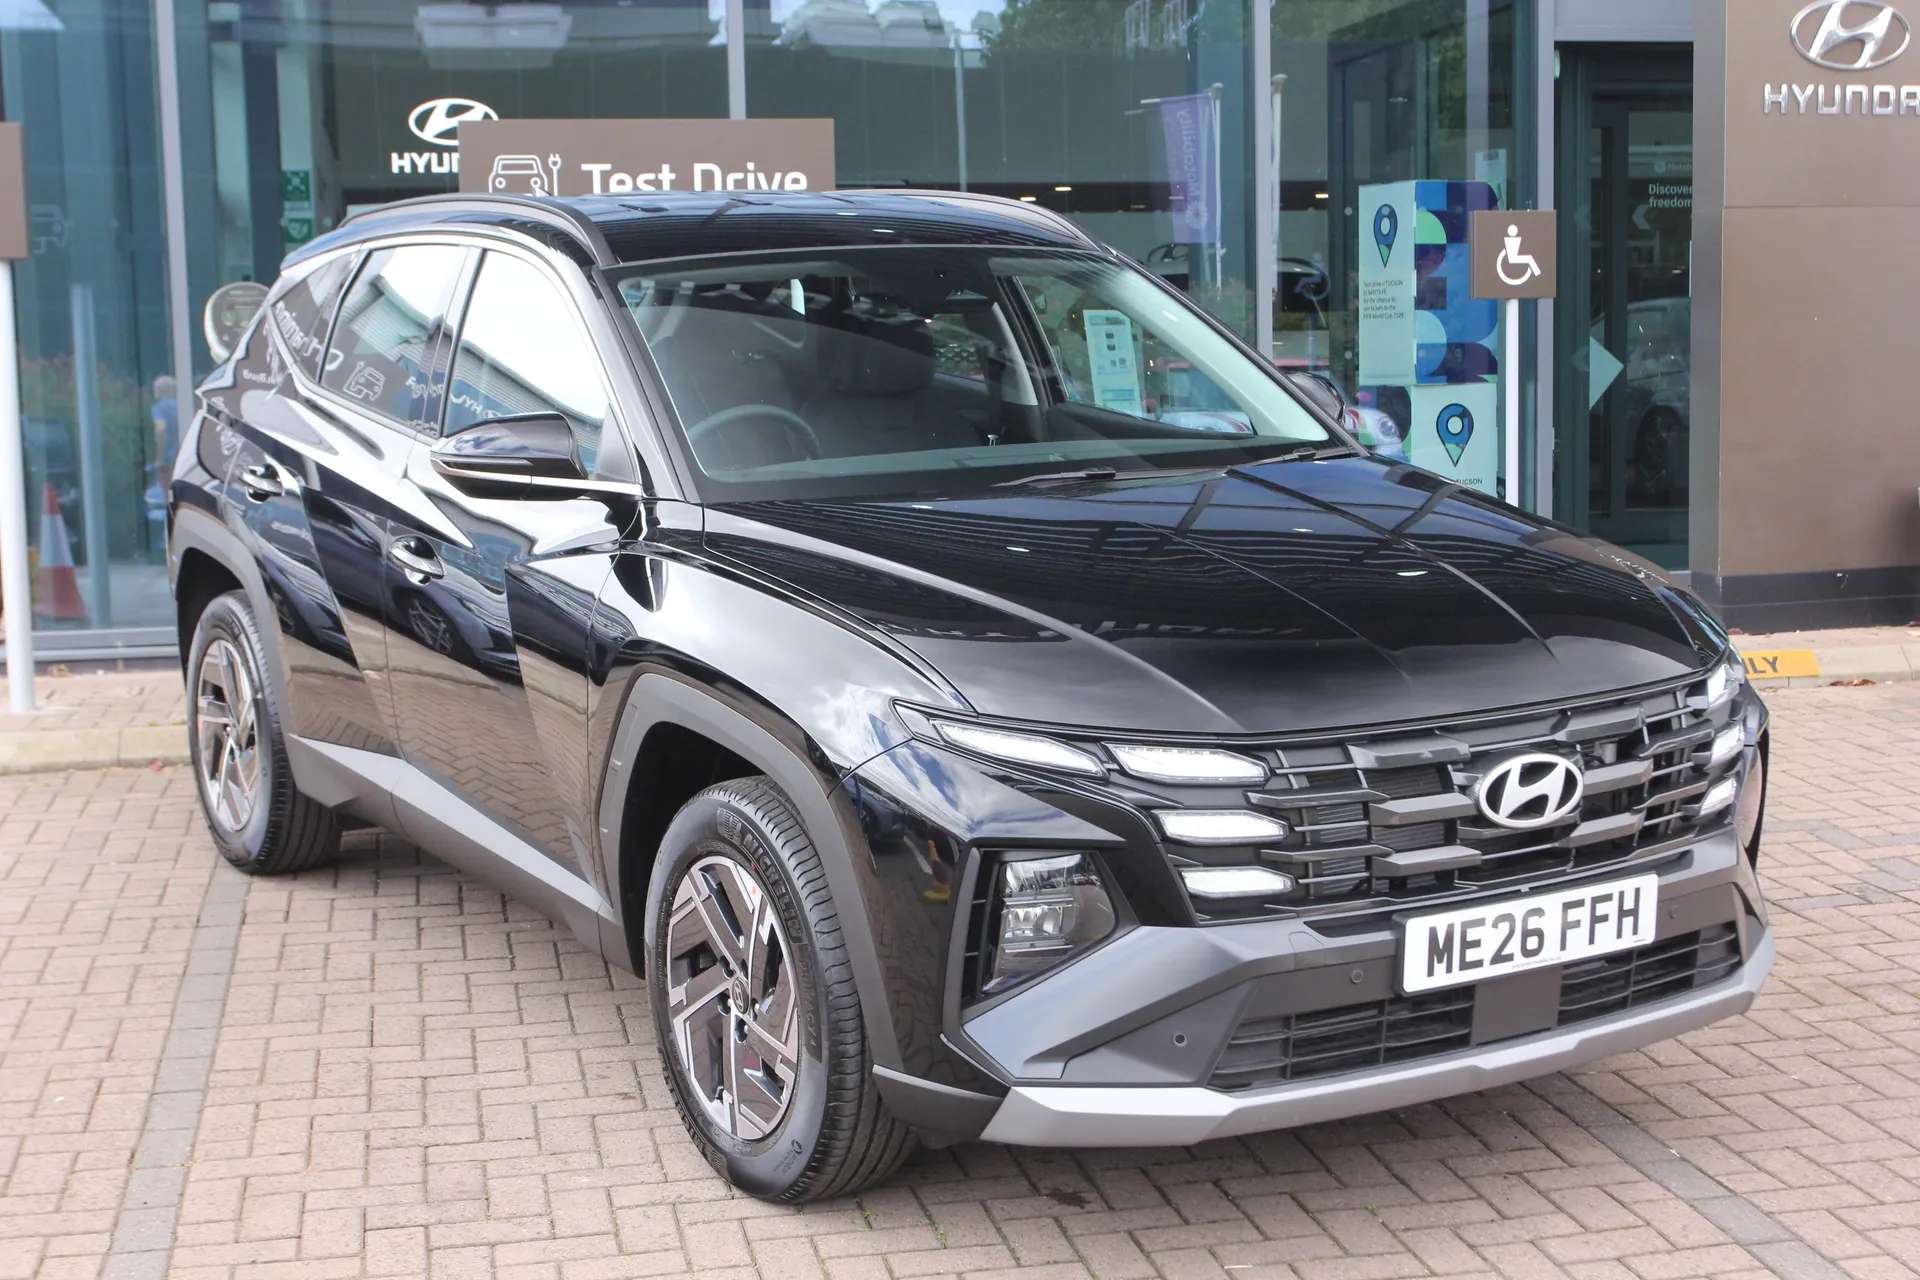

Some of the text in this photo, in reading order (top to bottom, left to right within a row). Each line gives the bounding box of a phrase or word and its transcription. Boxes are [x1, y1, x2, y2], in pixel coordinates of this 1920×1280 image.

[581, 161, 807, 192] Test Drive
[1427, 887, 1641, 978] ME26 FFH
